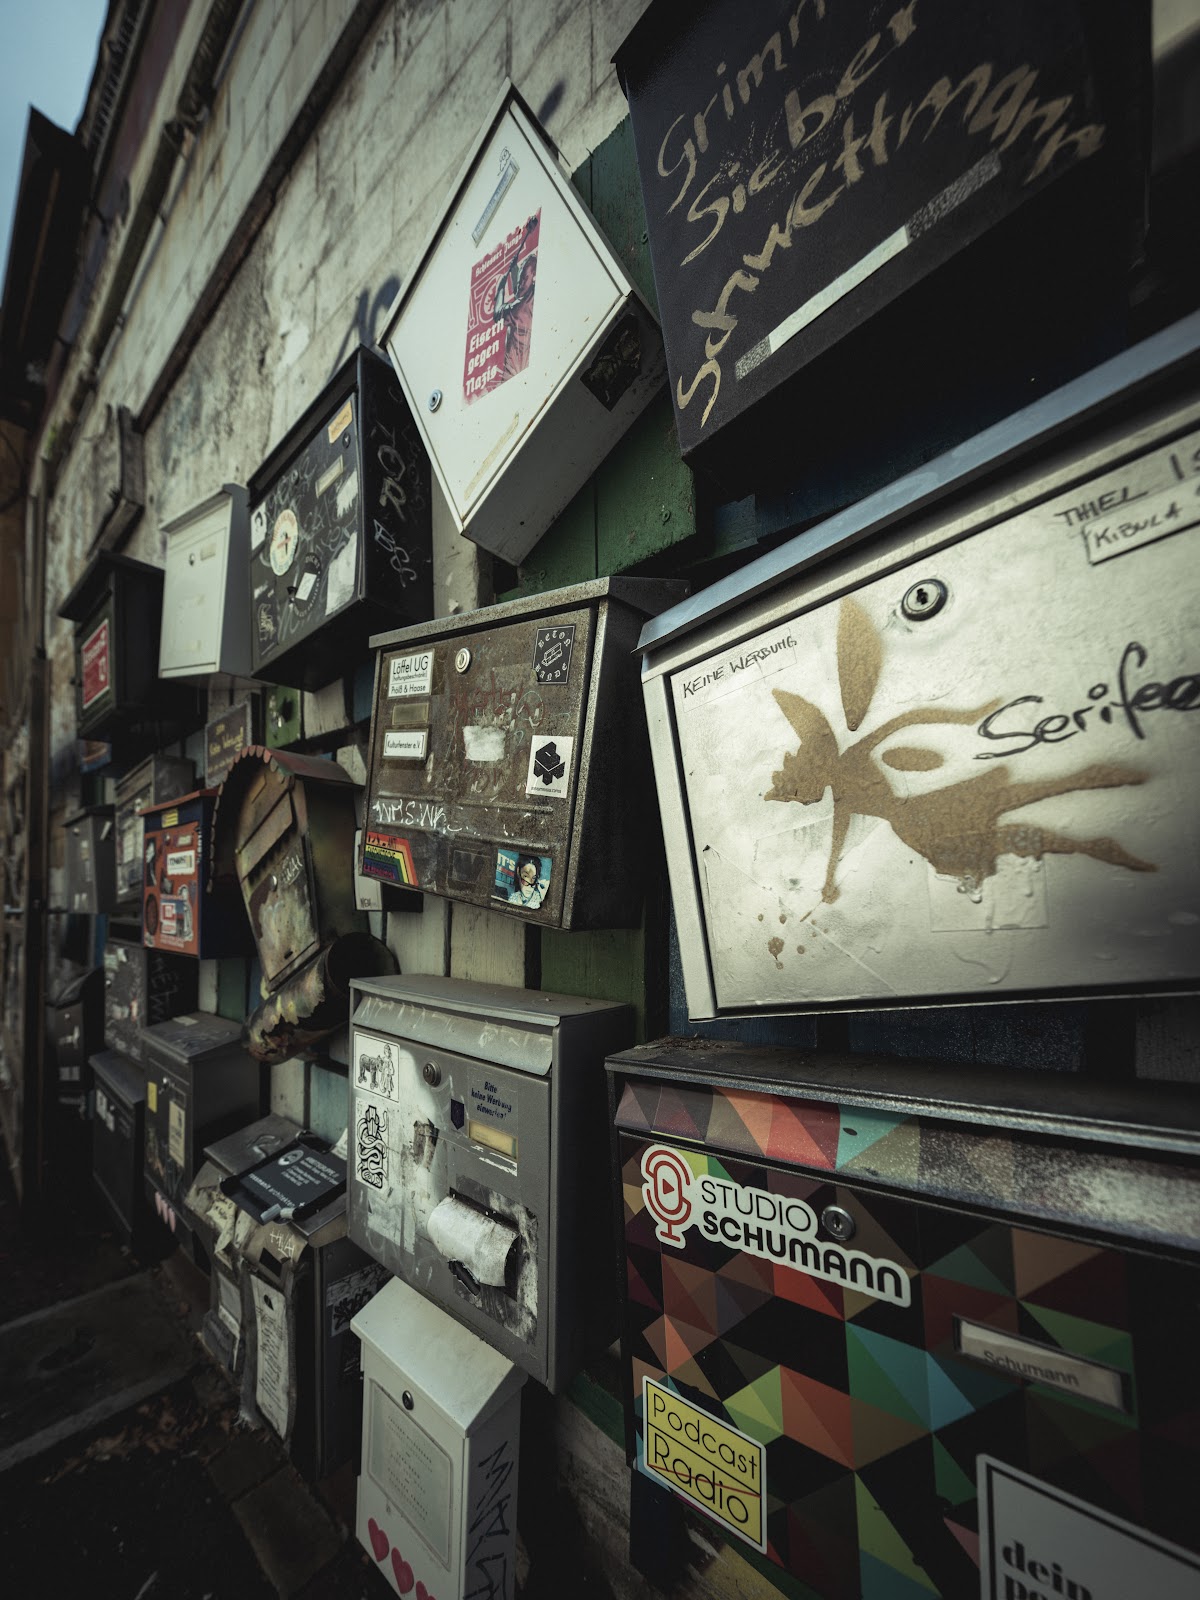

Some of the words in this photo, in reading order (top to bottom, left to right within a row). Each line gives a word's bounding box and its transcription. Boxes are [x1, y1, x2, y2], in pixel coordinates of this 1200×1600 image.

[677, 0, 916, 266] Sieber
[469, 318, 504, 353] Eisern
[467, 339, 500, 375] gegen
[465, 365, 498, 396] Nazis
[393, 657, 413, 675] Löffel
[414, 655, 429, 672] UG
[683, 666, 724, 698] KEINE
[729, 636, 797, 673] WERBUNG
[497, 852, 516, 872] IT'S
[471, 1087, 485, 1101] keine
[487, 1093, 512, 1113] Werbung
[485, 1081, 498, 1093] Bitte
[701, 1179, 811, 1232] STUDIO
[983, 1350, 1080, 1387] Schumann
[653, 1392, 758, 1480] Podcast
[654, 1432, 749, 1524] Radio
